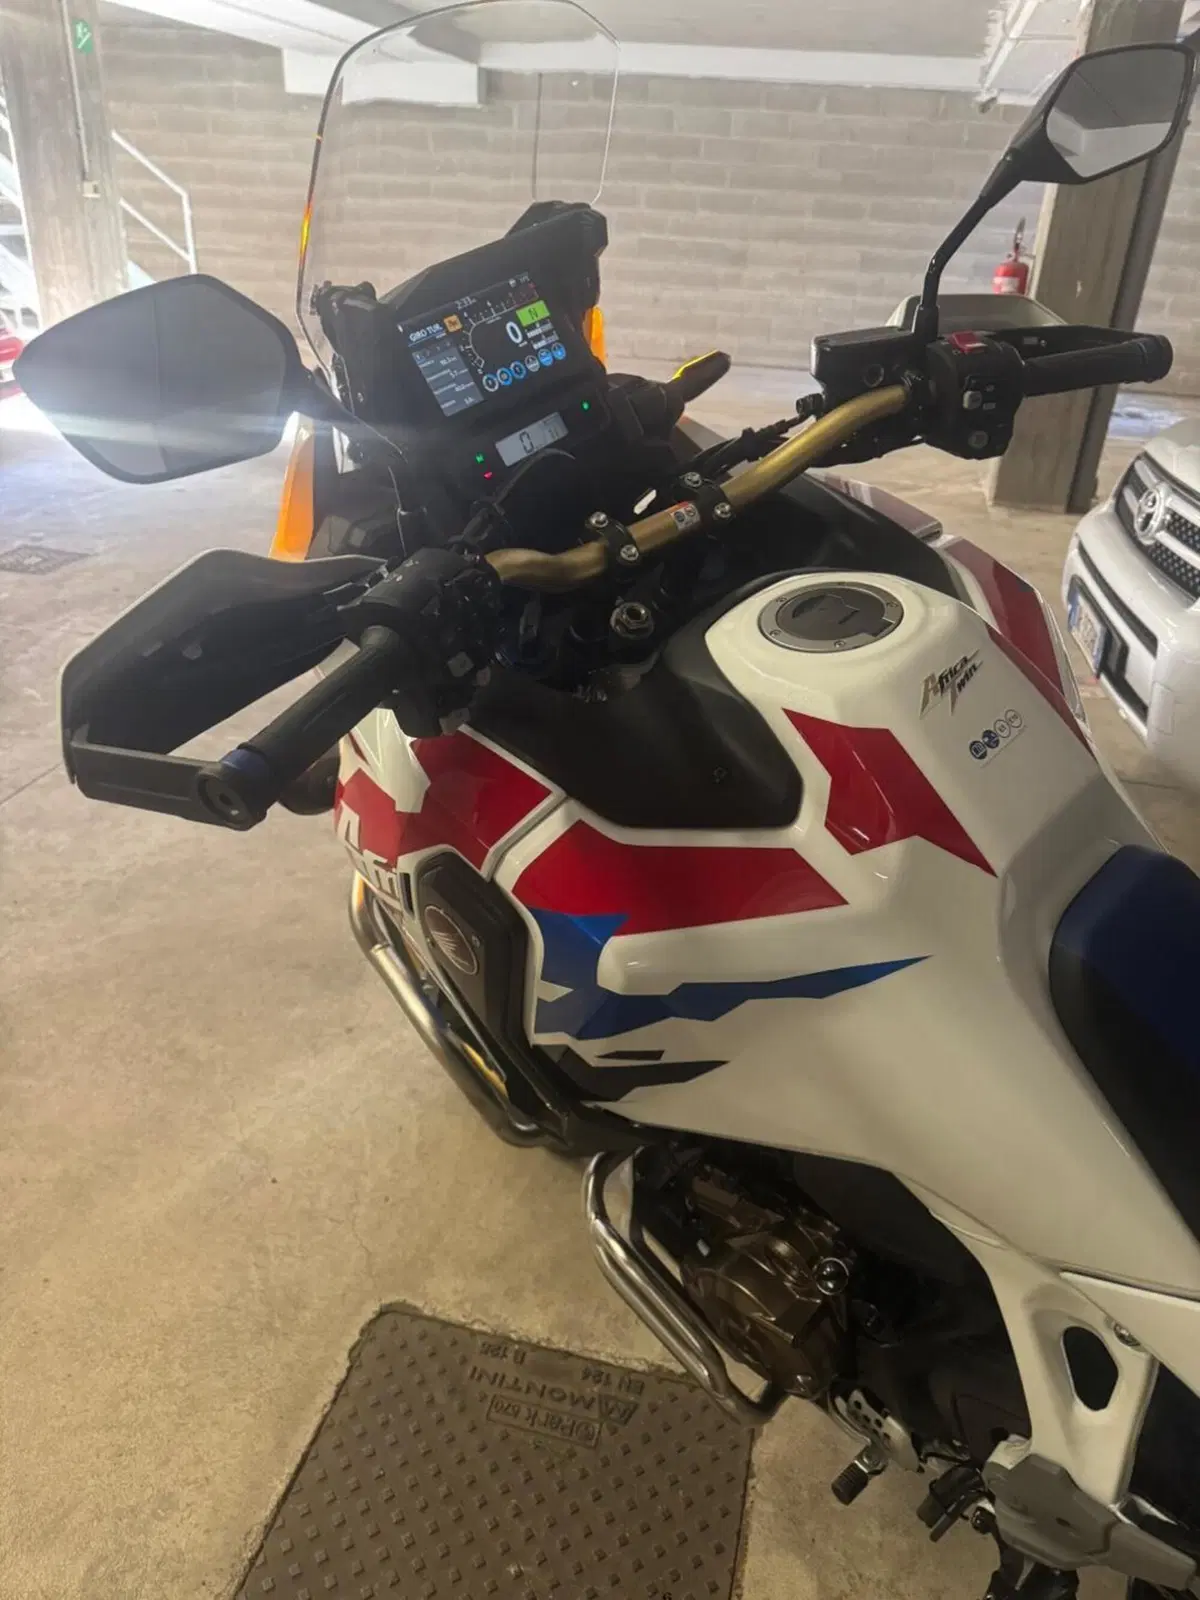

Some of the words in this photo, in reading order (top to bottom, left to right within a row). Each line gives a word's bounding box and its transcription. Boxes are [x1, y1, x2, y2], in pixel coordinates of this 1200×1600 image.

[505, 321, 523, 344] 0
[519, 430, 535, 454] 0
[919, 649, 980, 719] Africa
[948, 660, 984, 716] Twin
[468, 1365, 597, 1411] MONTINI
